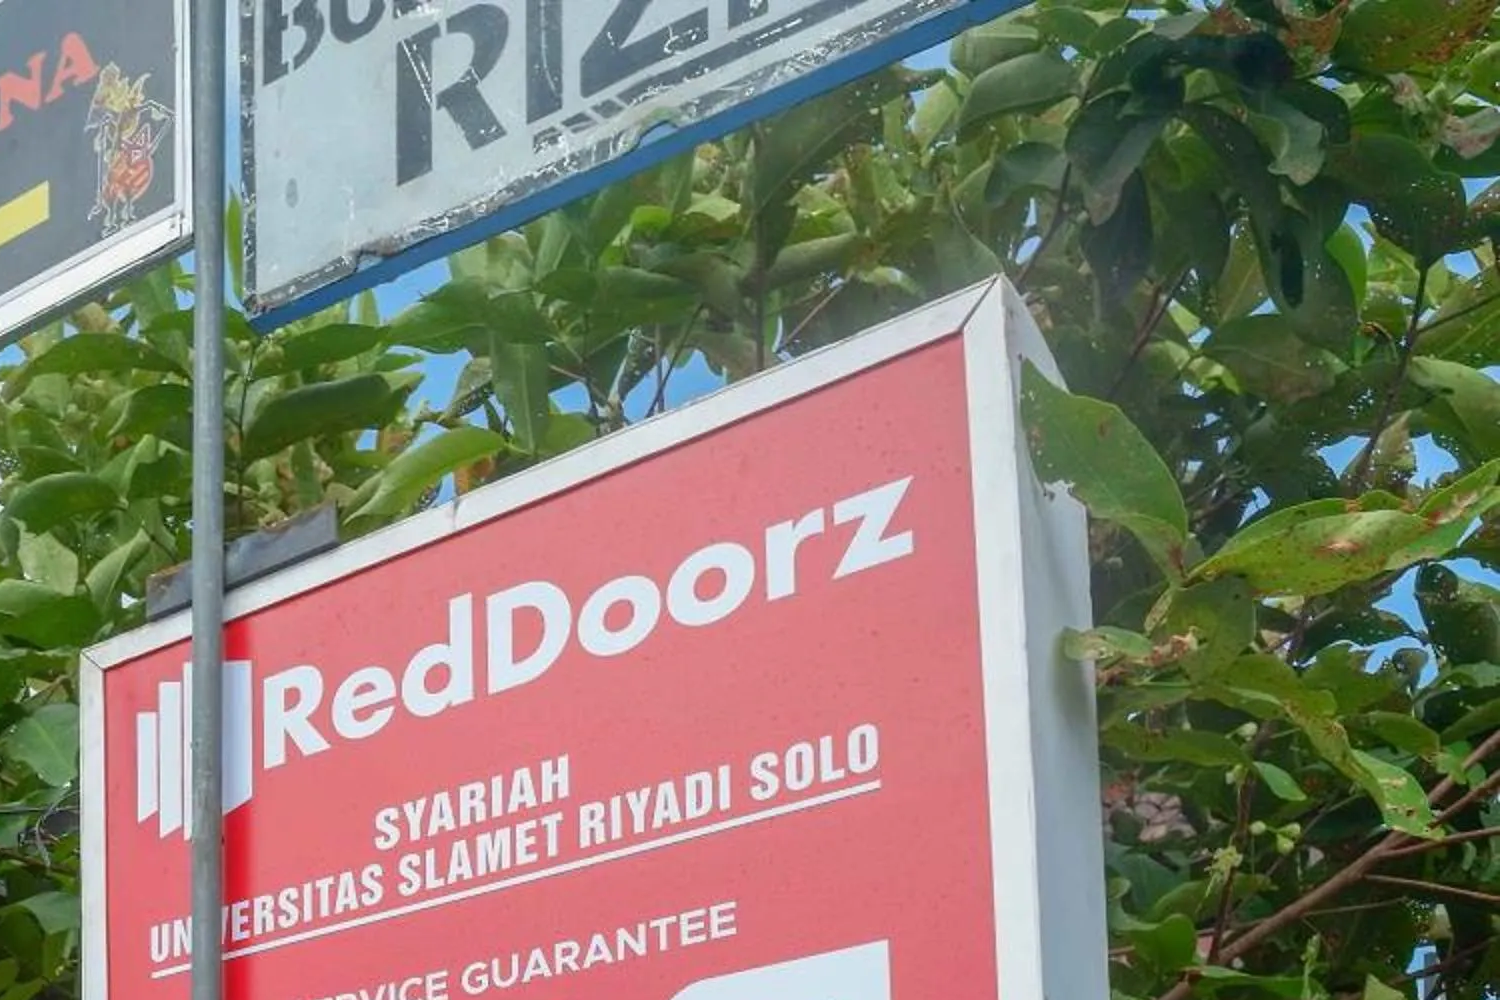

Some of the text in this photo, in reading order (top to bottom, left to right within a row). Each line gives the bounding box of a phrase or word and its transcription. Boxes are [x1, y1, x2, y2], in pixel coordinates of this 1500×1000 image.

[395, 0, 769, 187] RIZ
[262, 475, 915, 769] RedDoorz
[150, 722, 881, 963] UNERSITAS SLAMET RIYADI SOLO
[374, 753, 570, 851] SYARIAH
[460, 900, 739, 996] GUARANTEE
